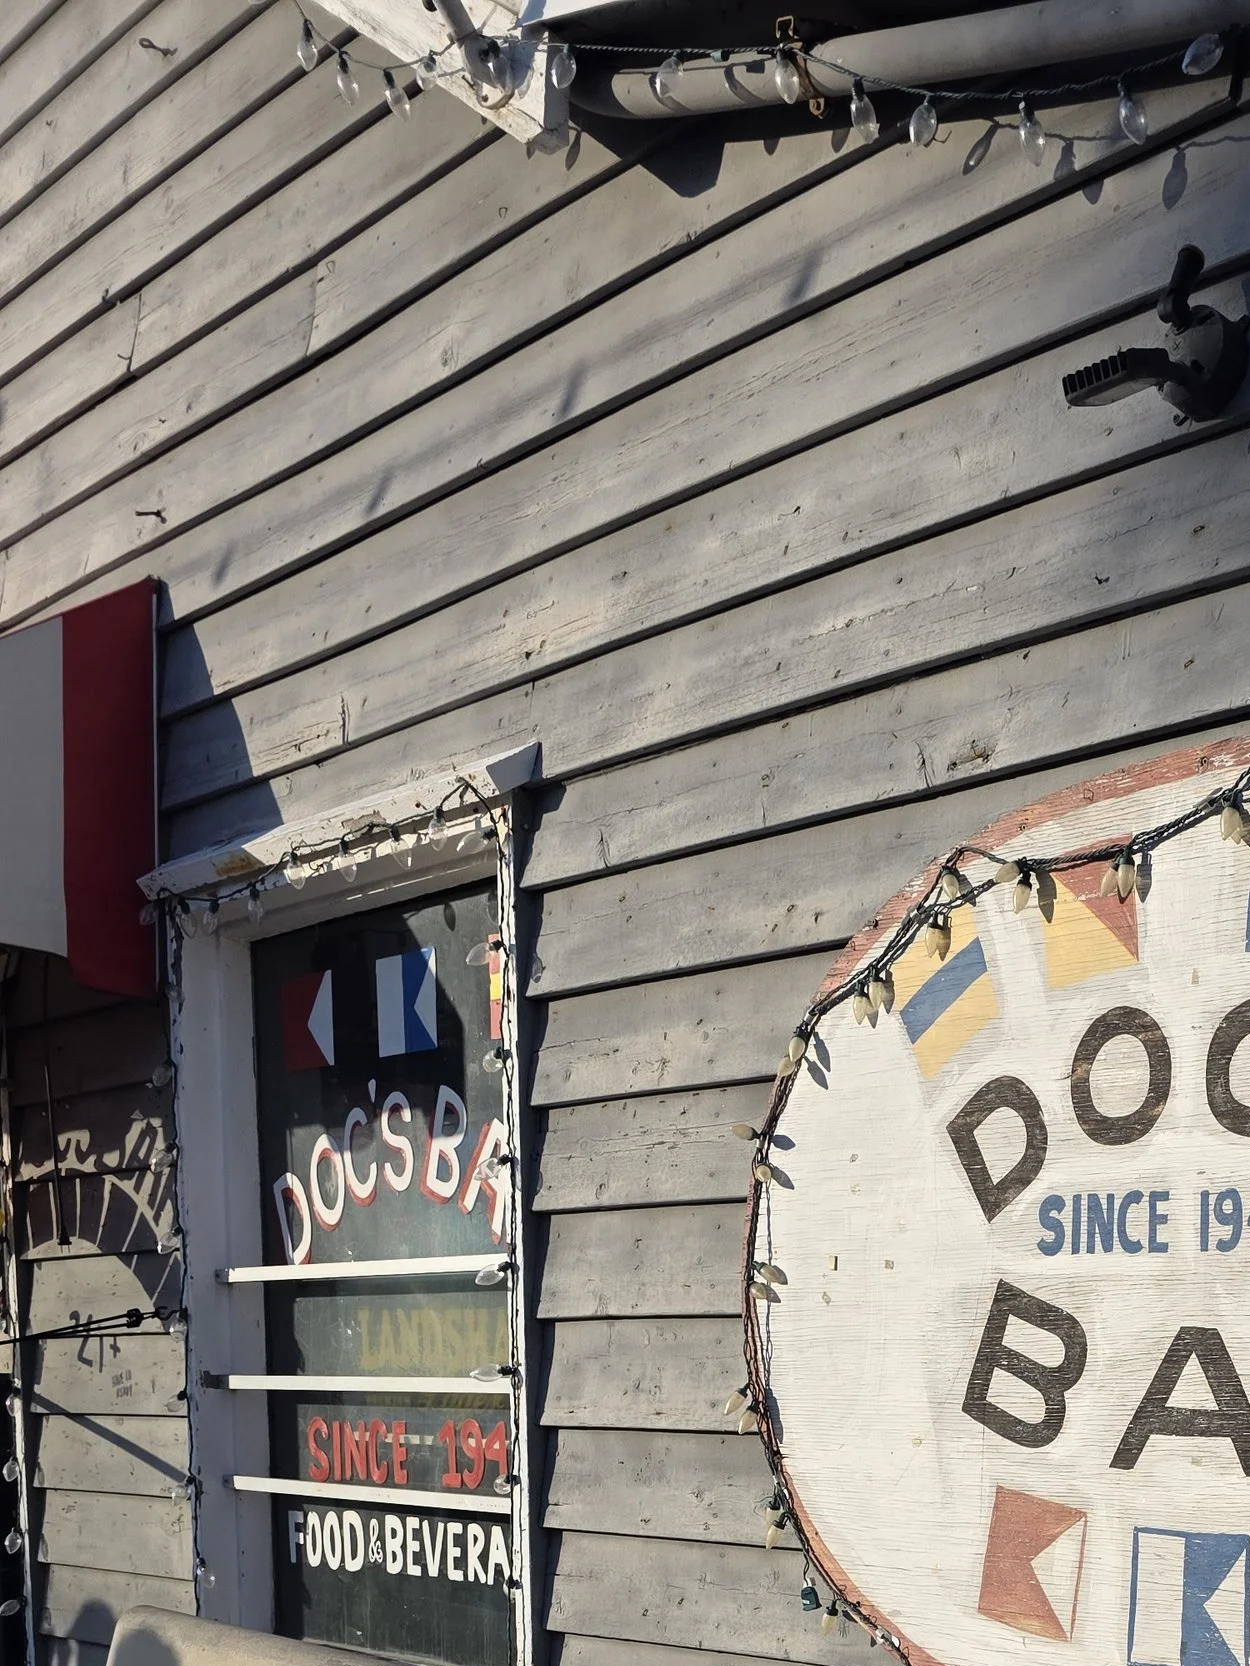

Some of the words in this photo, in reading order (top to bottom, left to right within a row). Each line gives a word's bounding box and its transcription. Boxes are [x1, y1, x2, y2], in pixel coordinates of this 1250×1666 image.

[273, 1079, 414, 1264] DOC'S
[1037, 1189, 1170, 1257] SINCE
[307, 1416, 408, 1483] SINCE
[437, 1418, 509, 1489] 194
[288, 1510, 365, 1572] FOOD
[385, 1514, 511, 1586] BEVERA
